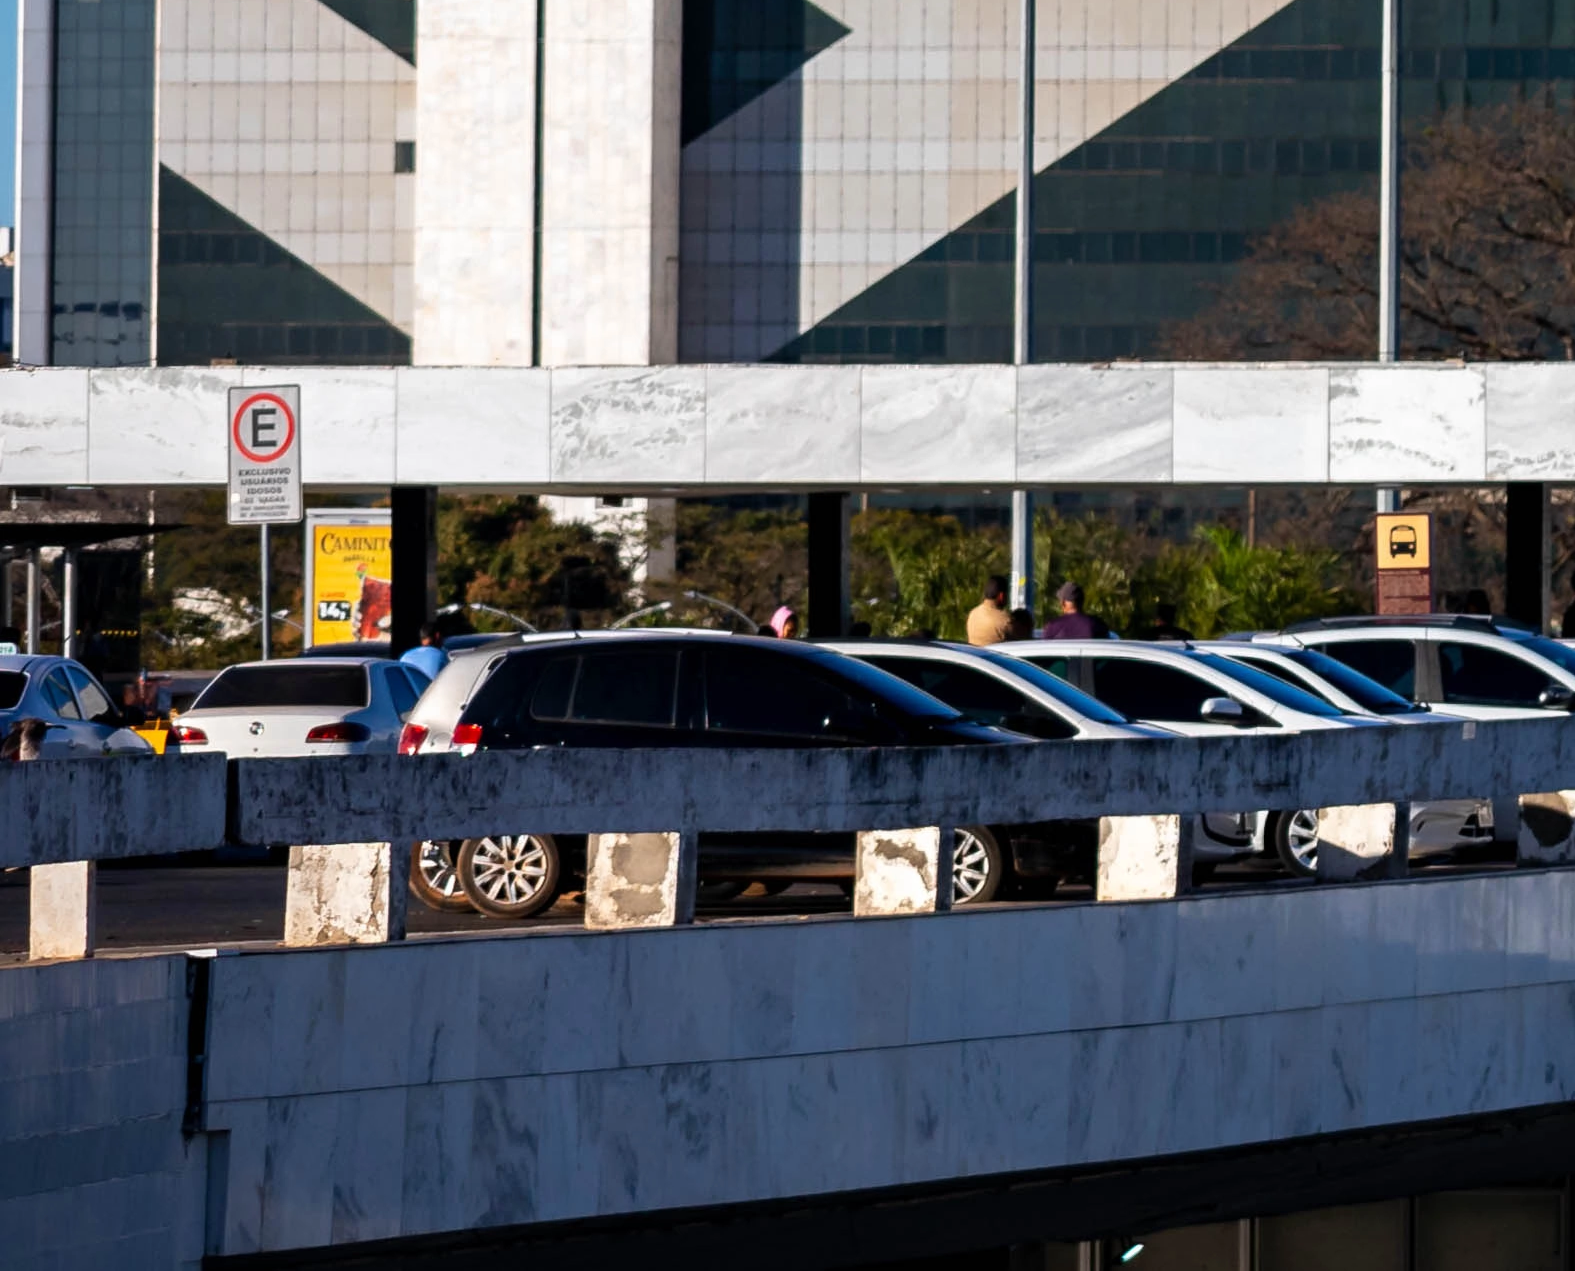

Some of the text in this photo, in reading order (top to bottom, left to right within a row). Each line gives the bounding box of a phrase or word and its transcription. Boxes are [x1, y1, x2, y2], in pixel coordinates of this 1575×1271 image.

[252, 408, 277, 447] E
[239, 467, 291, 476] EXCLUSIVO
[241, 477, 288, 485] USUÁRIOS
[247, 487, 282, 495] IDOSOS
[321, 533, 391, 555] CAMINIT
